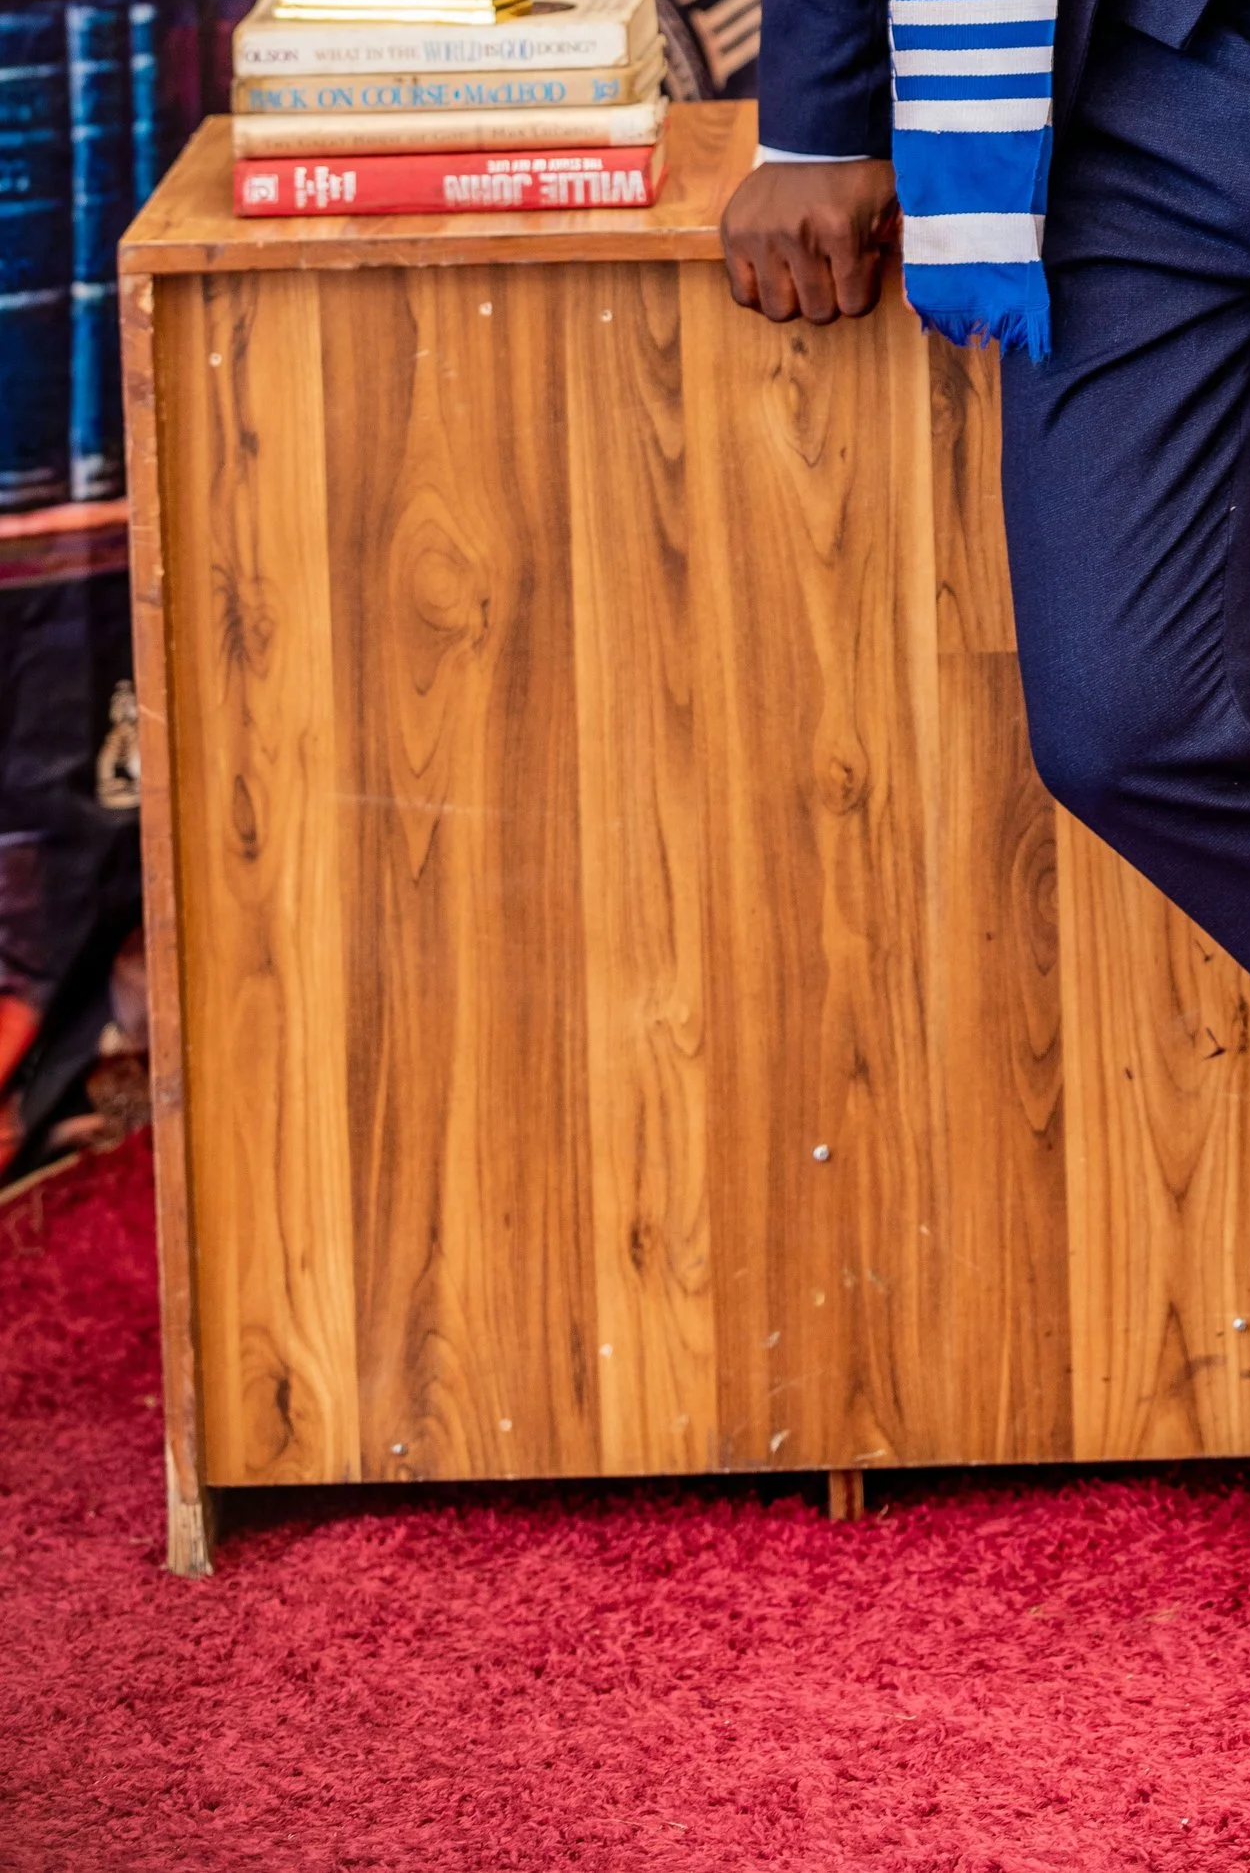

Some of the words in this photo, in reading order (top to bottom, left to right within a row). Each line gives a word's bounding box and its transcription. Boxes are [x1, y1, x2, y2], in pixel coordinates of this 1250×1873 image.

[245, 48, 299, 64] OLSON
[313, 47, 361, 62] WHAT
[366, 47, 384, 60] IN
[388, 45, 421, 60] THE
[422, 40, 482, 62] WORLD
[500, 39, 533, 61] GOD
[250, 87, 308, 110] BACK
[317, 86, 354, 108] ON
[362, 83, 450, 107] COURSE
[444, 173, 533, 207] JOHN
[538, 170, 647, 205] WILLIE
